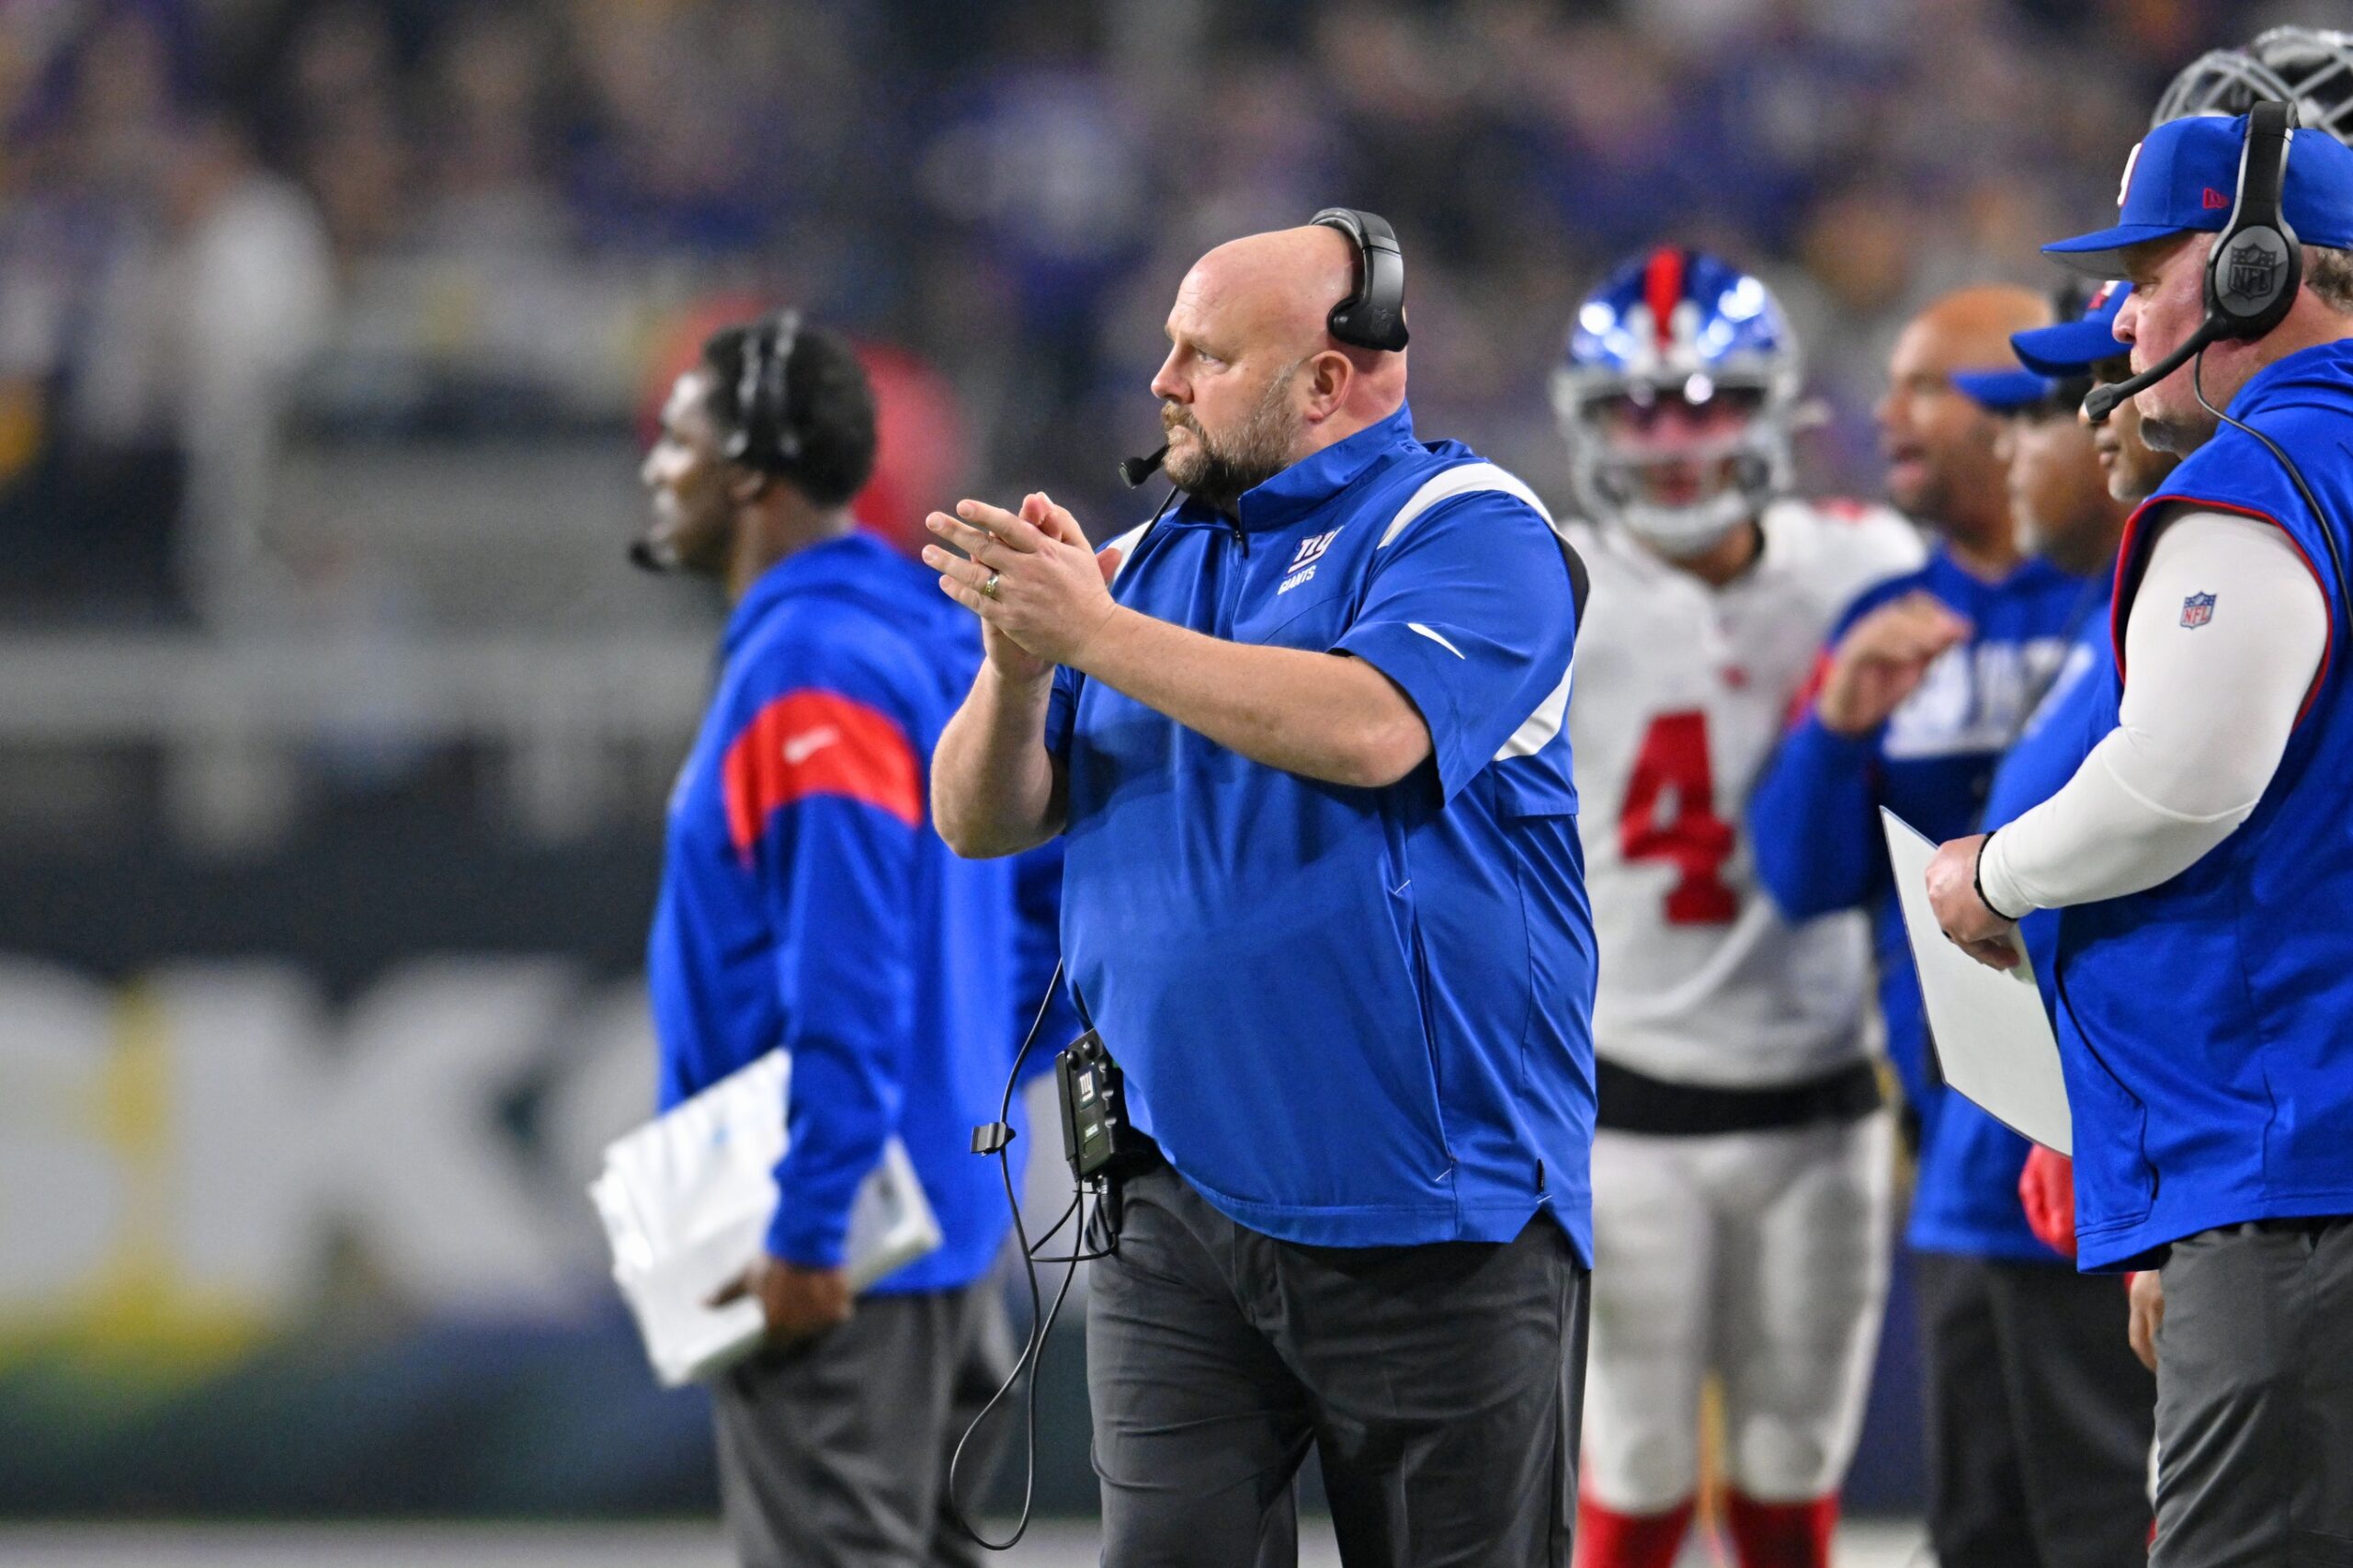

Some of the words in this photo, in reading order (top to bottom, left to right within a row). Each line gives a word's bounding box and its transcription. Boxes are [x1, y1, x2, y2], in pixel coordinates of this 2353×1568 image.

[2231, 265, 2268, 291] NFL
[1278, 565, 1316, 596] GIANTS
[2185, 606, 2208, 624] NFL
[1619, 709, 1737, 927] 4
